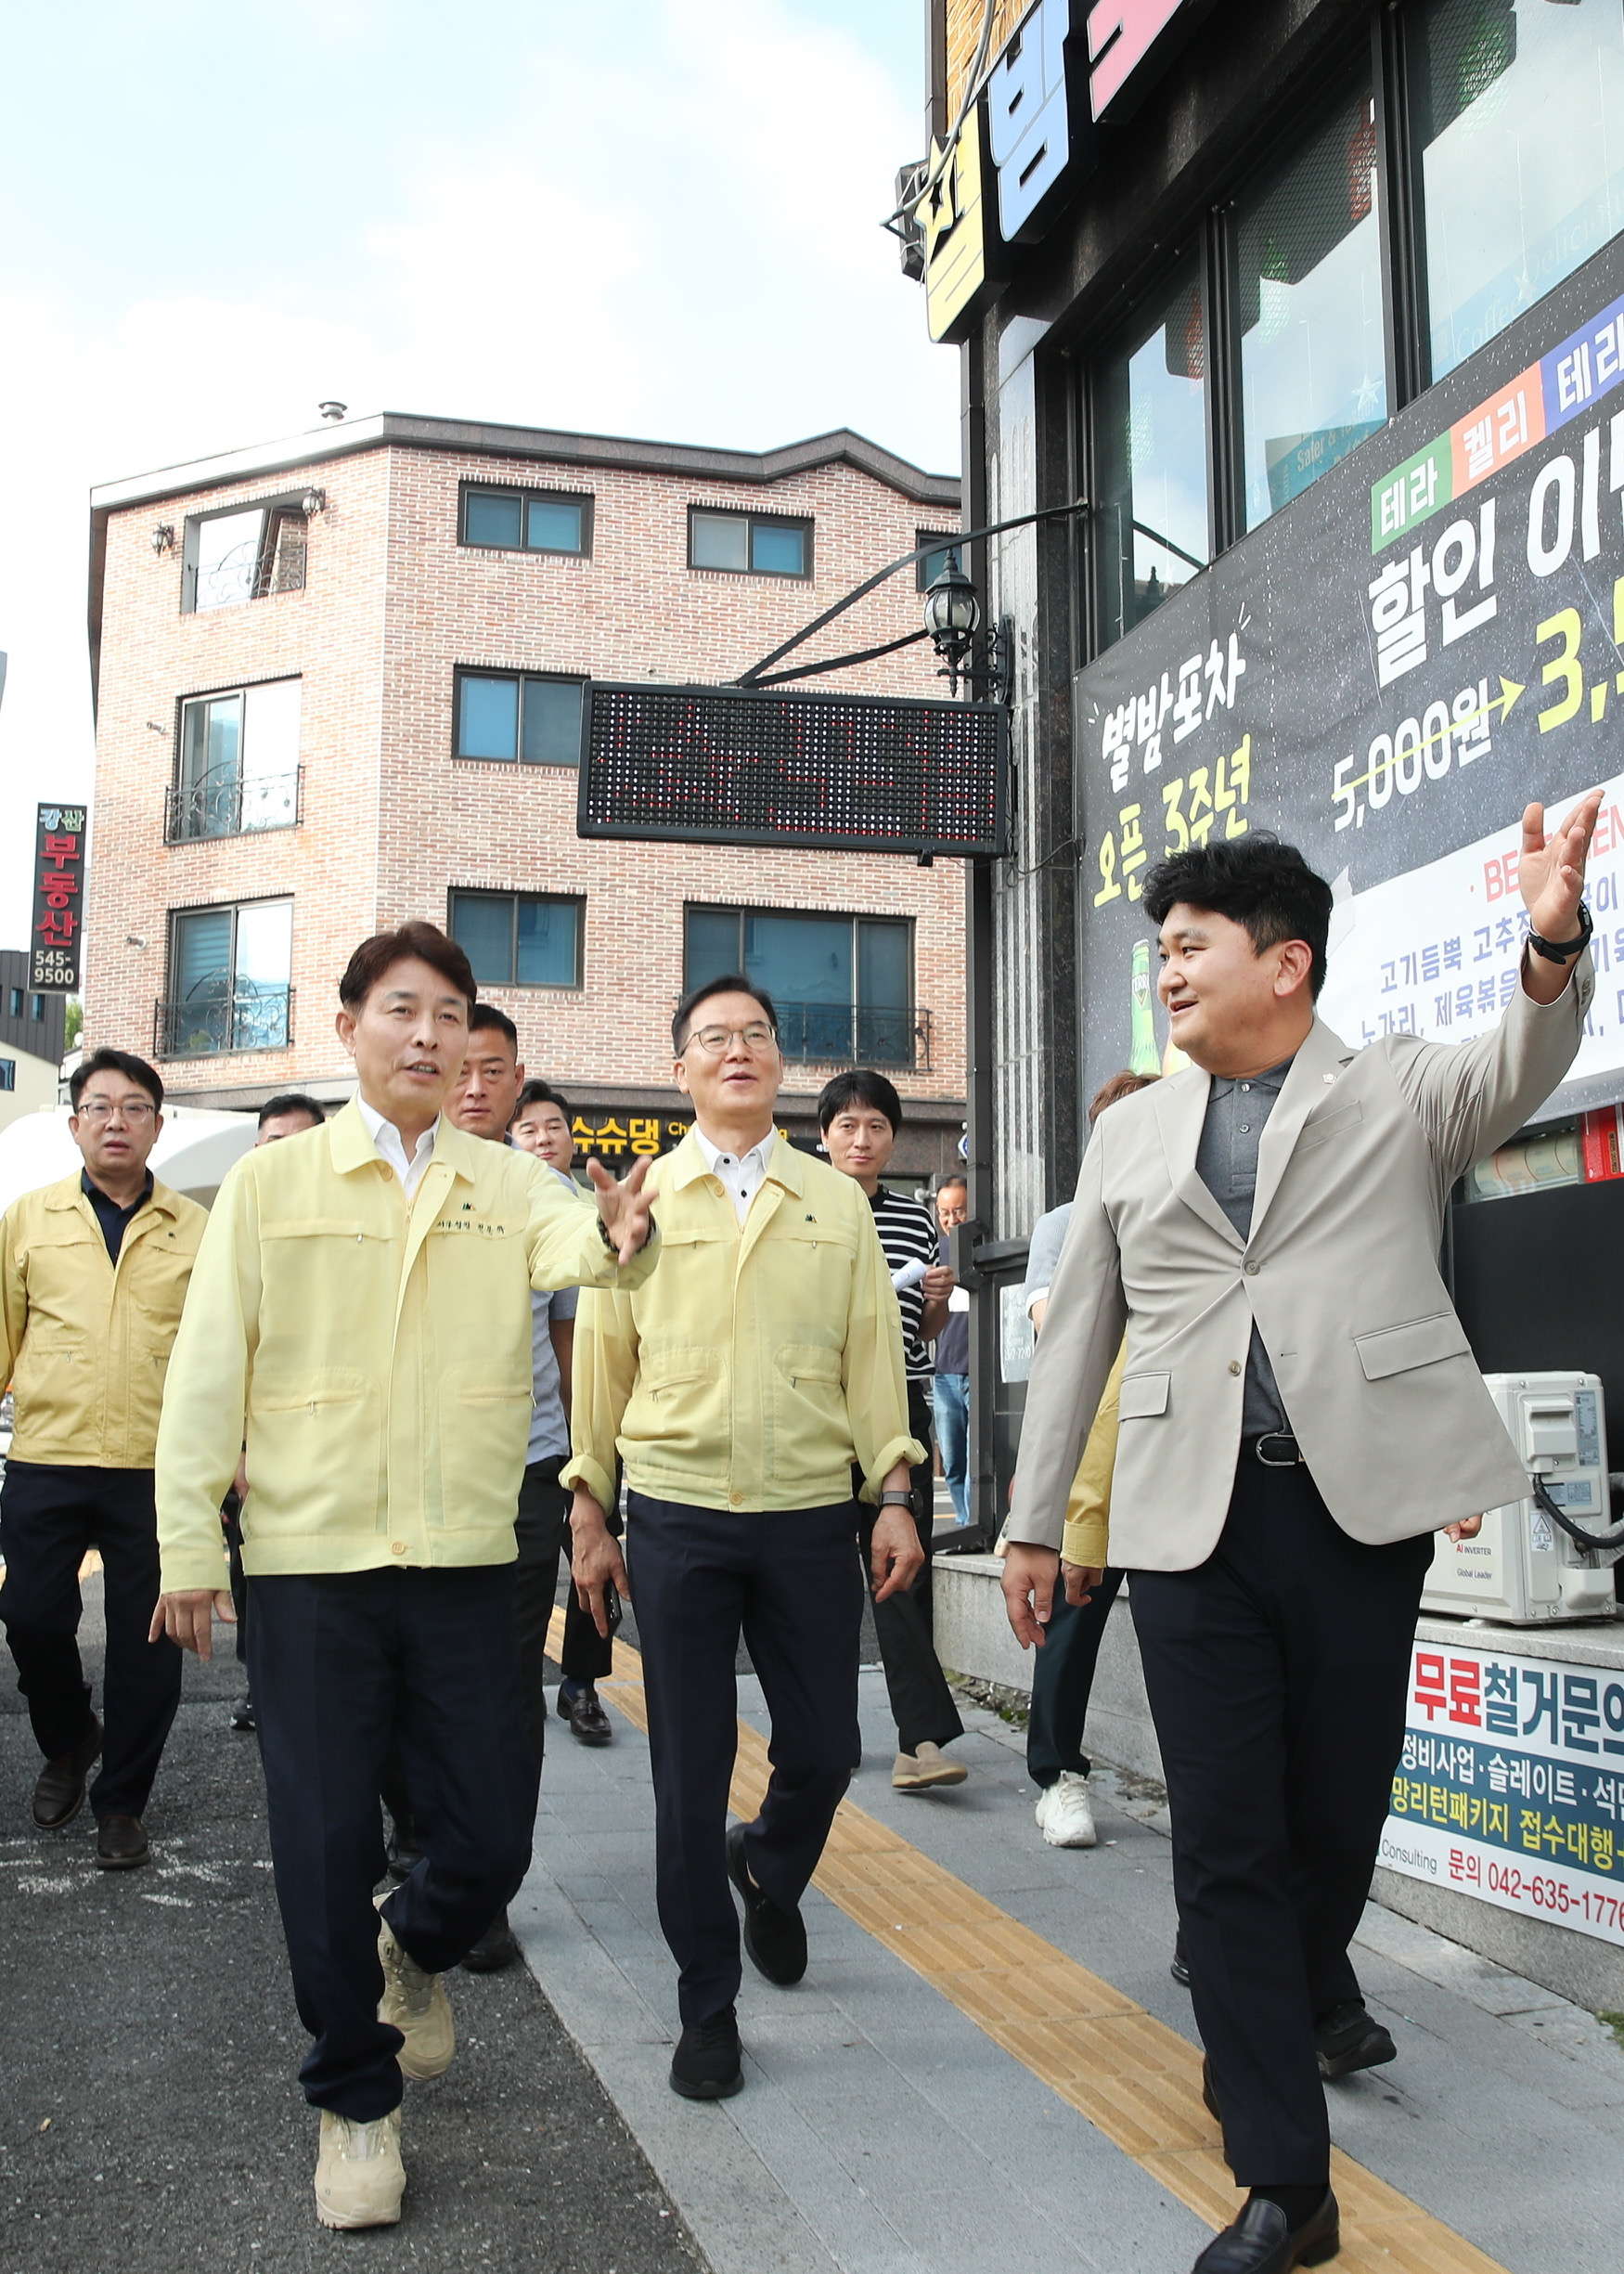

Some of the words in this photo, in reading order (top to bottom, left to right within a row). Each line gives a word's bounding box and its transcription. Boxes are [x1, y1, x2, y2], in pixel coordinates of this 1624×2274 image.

[1380, 456, 1438, 538] 테라
[1463, 390, 1528, 481] 켈리
[1368, 497, 1499, 689] 할인
[1526, 408, 1624, 578] 이
[1101, 631, 1247, 795] 별밤포차
[1333, 677, 1492, 833] 5,000원
[1535, 575, 1624, 735] 3,
[39, 808, 84, 833] 강산
[1093, 802, 1148, 909] 오픈
[1162, 732, 1252, 860] 3주년
[35, 833, 81, 948] 부동산
[34, 968, 74, 985] 9500
[35, 950, 71, 967] 545-
[1380, 935, 1463, 994] 고기듬뿍
[1464, 1545, 1492, 1557] INVERTER
[1392, 1776, 1510, 1842] 망리턴패키지
[1518, 1808, 1614, 1871] 접수대행
[1592, 1775, 1624, 1823] 석
[1381, 1838, 1437, 1875] Consulting
[1448, 1847, 1482, 1889] 문의
